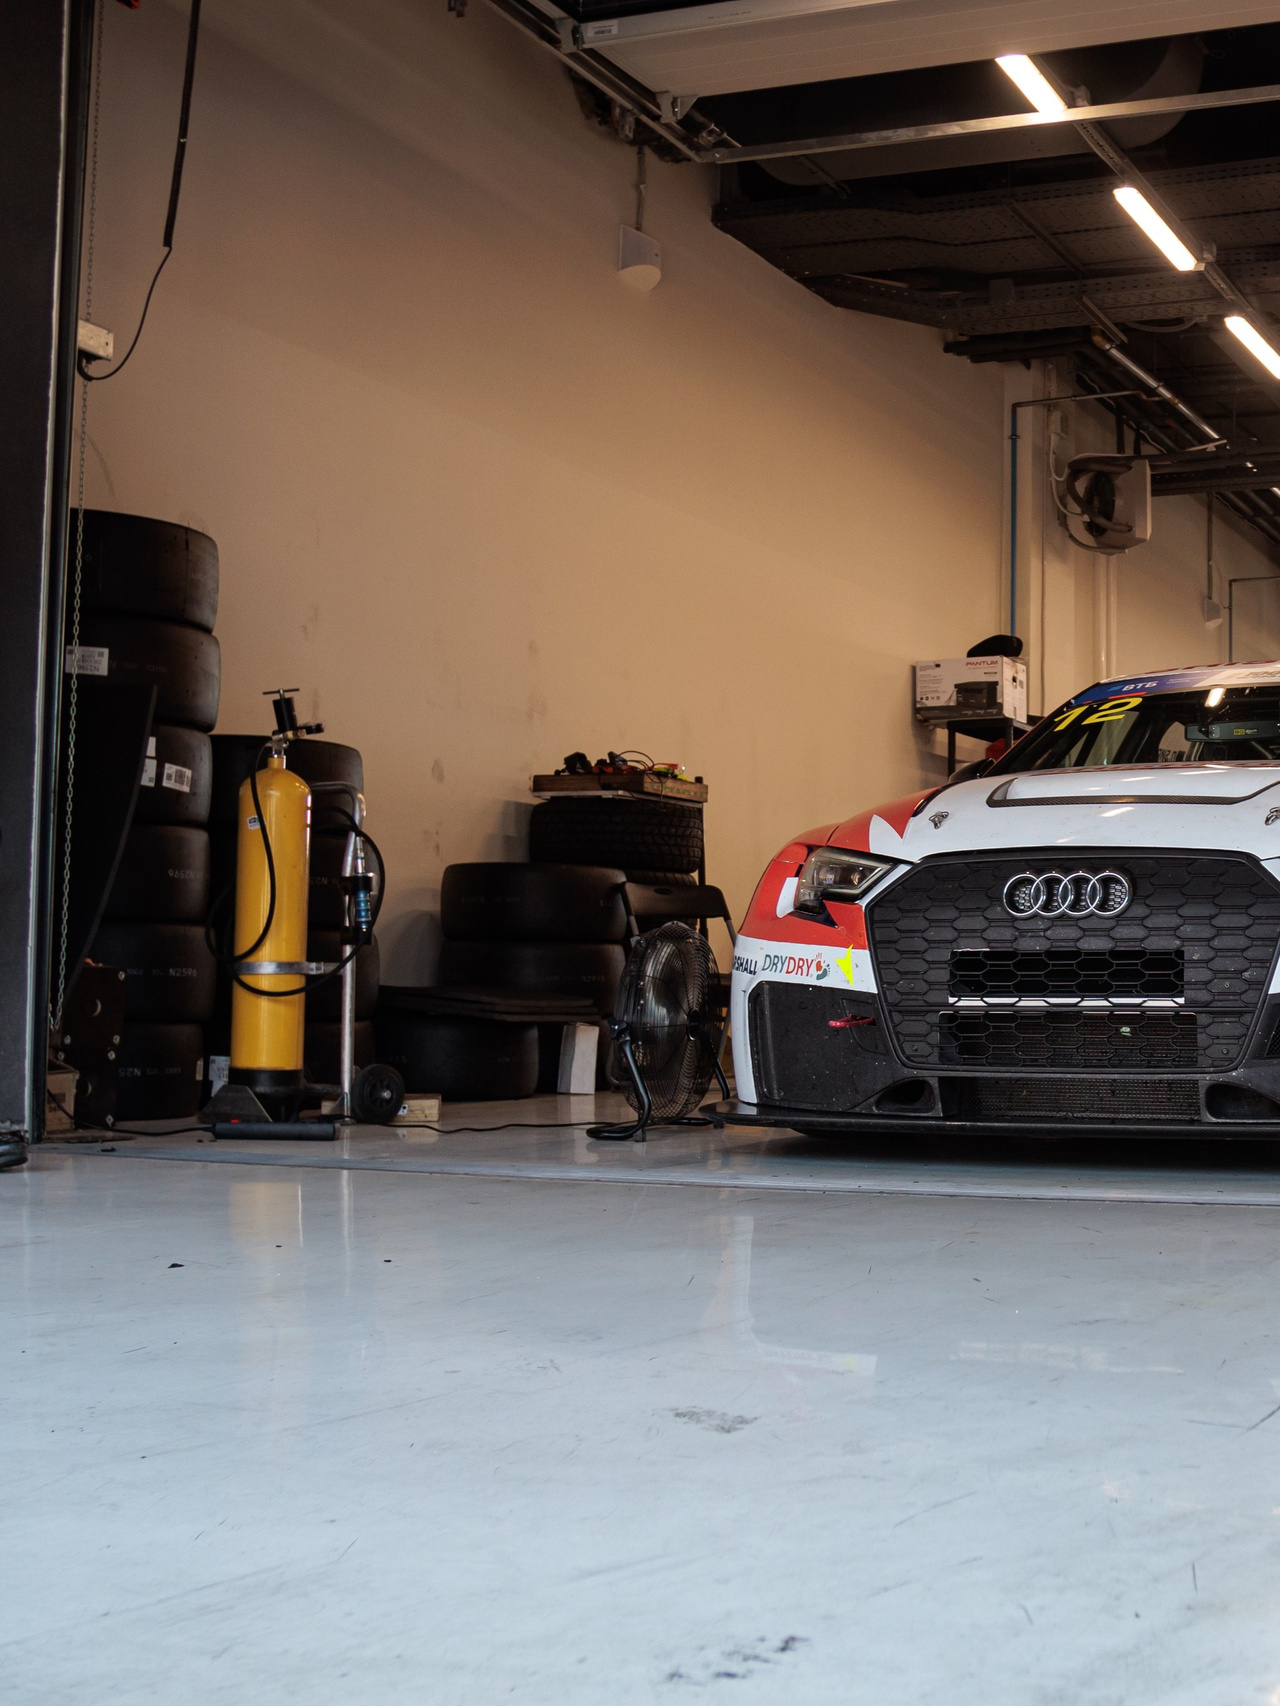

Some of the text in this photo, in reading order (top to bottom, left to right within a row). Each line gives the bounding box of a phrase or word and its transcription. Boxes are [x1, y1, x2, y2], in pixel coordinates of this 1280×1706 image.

[1054, 697, 1143, 732] 12
[168, 968, 198, 977] N2596
[761, 953, 815, 977] DRYDRY
